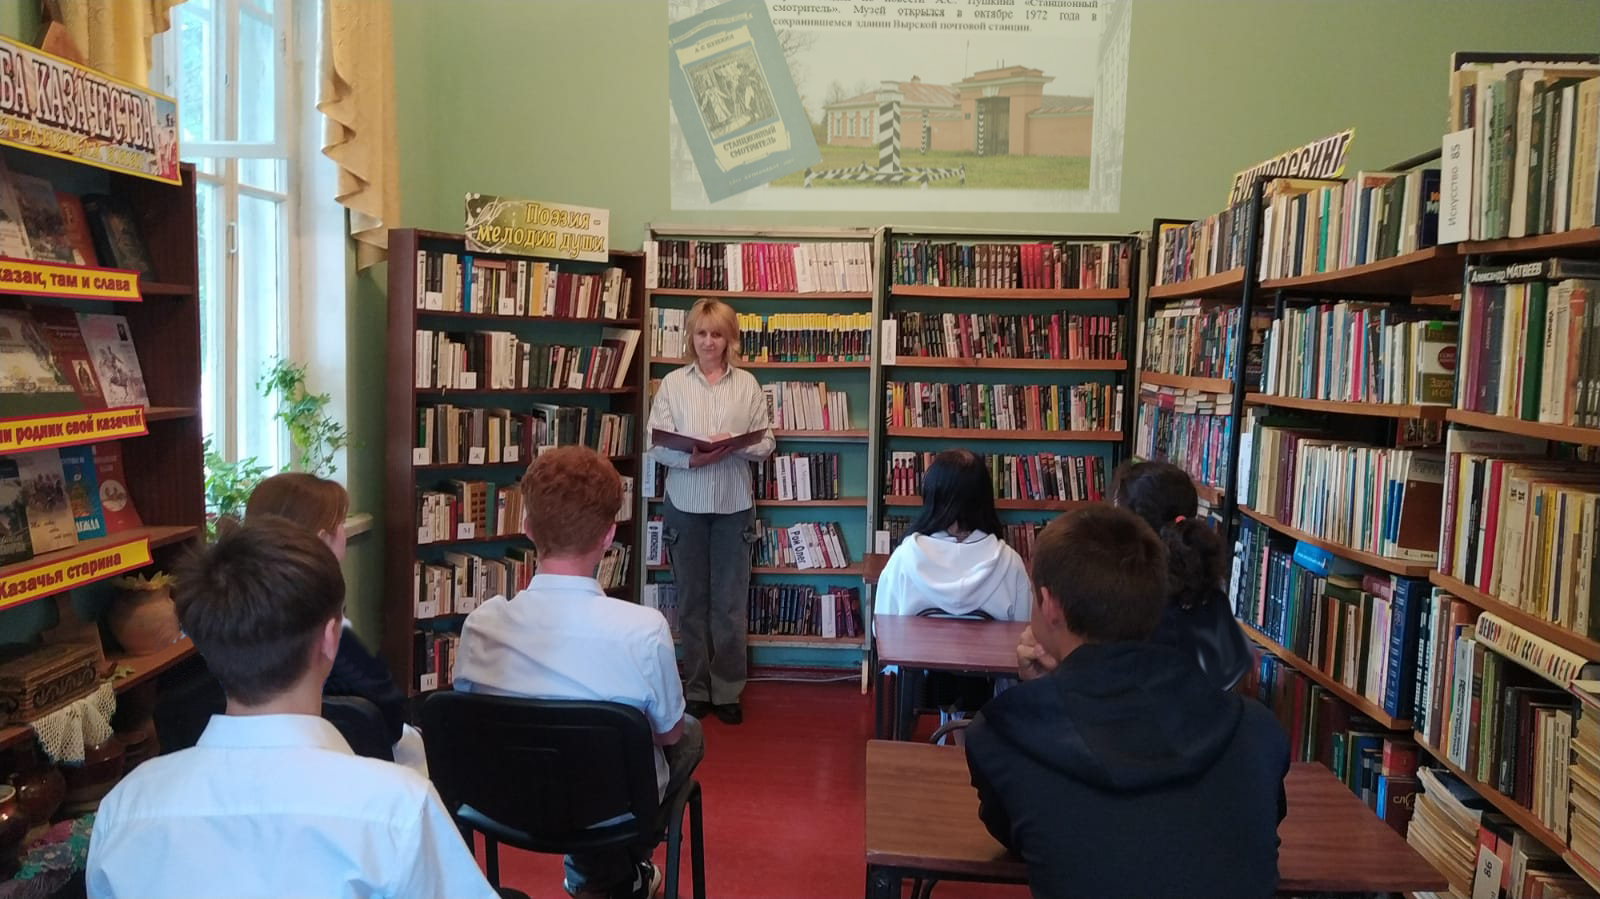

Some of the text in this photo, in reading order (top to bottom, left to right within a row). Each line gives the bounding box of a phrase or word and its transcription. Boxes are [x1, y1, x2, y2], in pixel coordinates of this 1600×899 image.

[772, 4, 1097, 21] смотритель». Музей открылся в октябре 1972 года в
[772, 17, 1032, 32] сохранившемся здании Вырской почтовой станции.
[32, 59, 156, 155] КАЗАЧЕСТВА
[722, 125, 777, 151] СТАНЦИОННЫЙ
[729, 136, 777, 158] СМОТРИТЕЛЬ
[1447, 143, 1461, 226] Искусство 85
[525, 202, 590, 229] Поэзия
[476, 224, 606, 259] мелодия души
[50, 273, 78, 288] там
[82, 277, 90, 289] и
[94, 277, 131, 292] слава
[16, 424, 63, 445] родник
[66, 415, 94, 434] свой
[97, 410, 142, 431] казачий
[0, 552, 122, 600] Казачья старина
